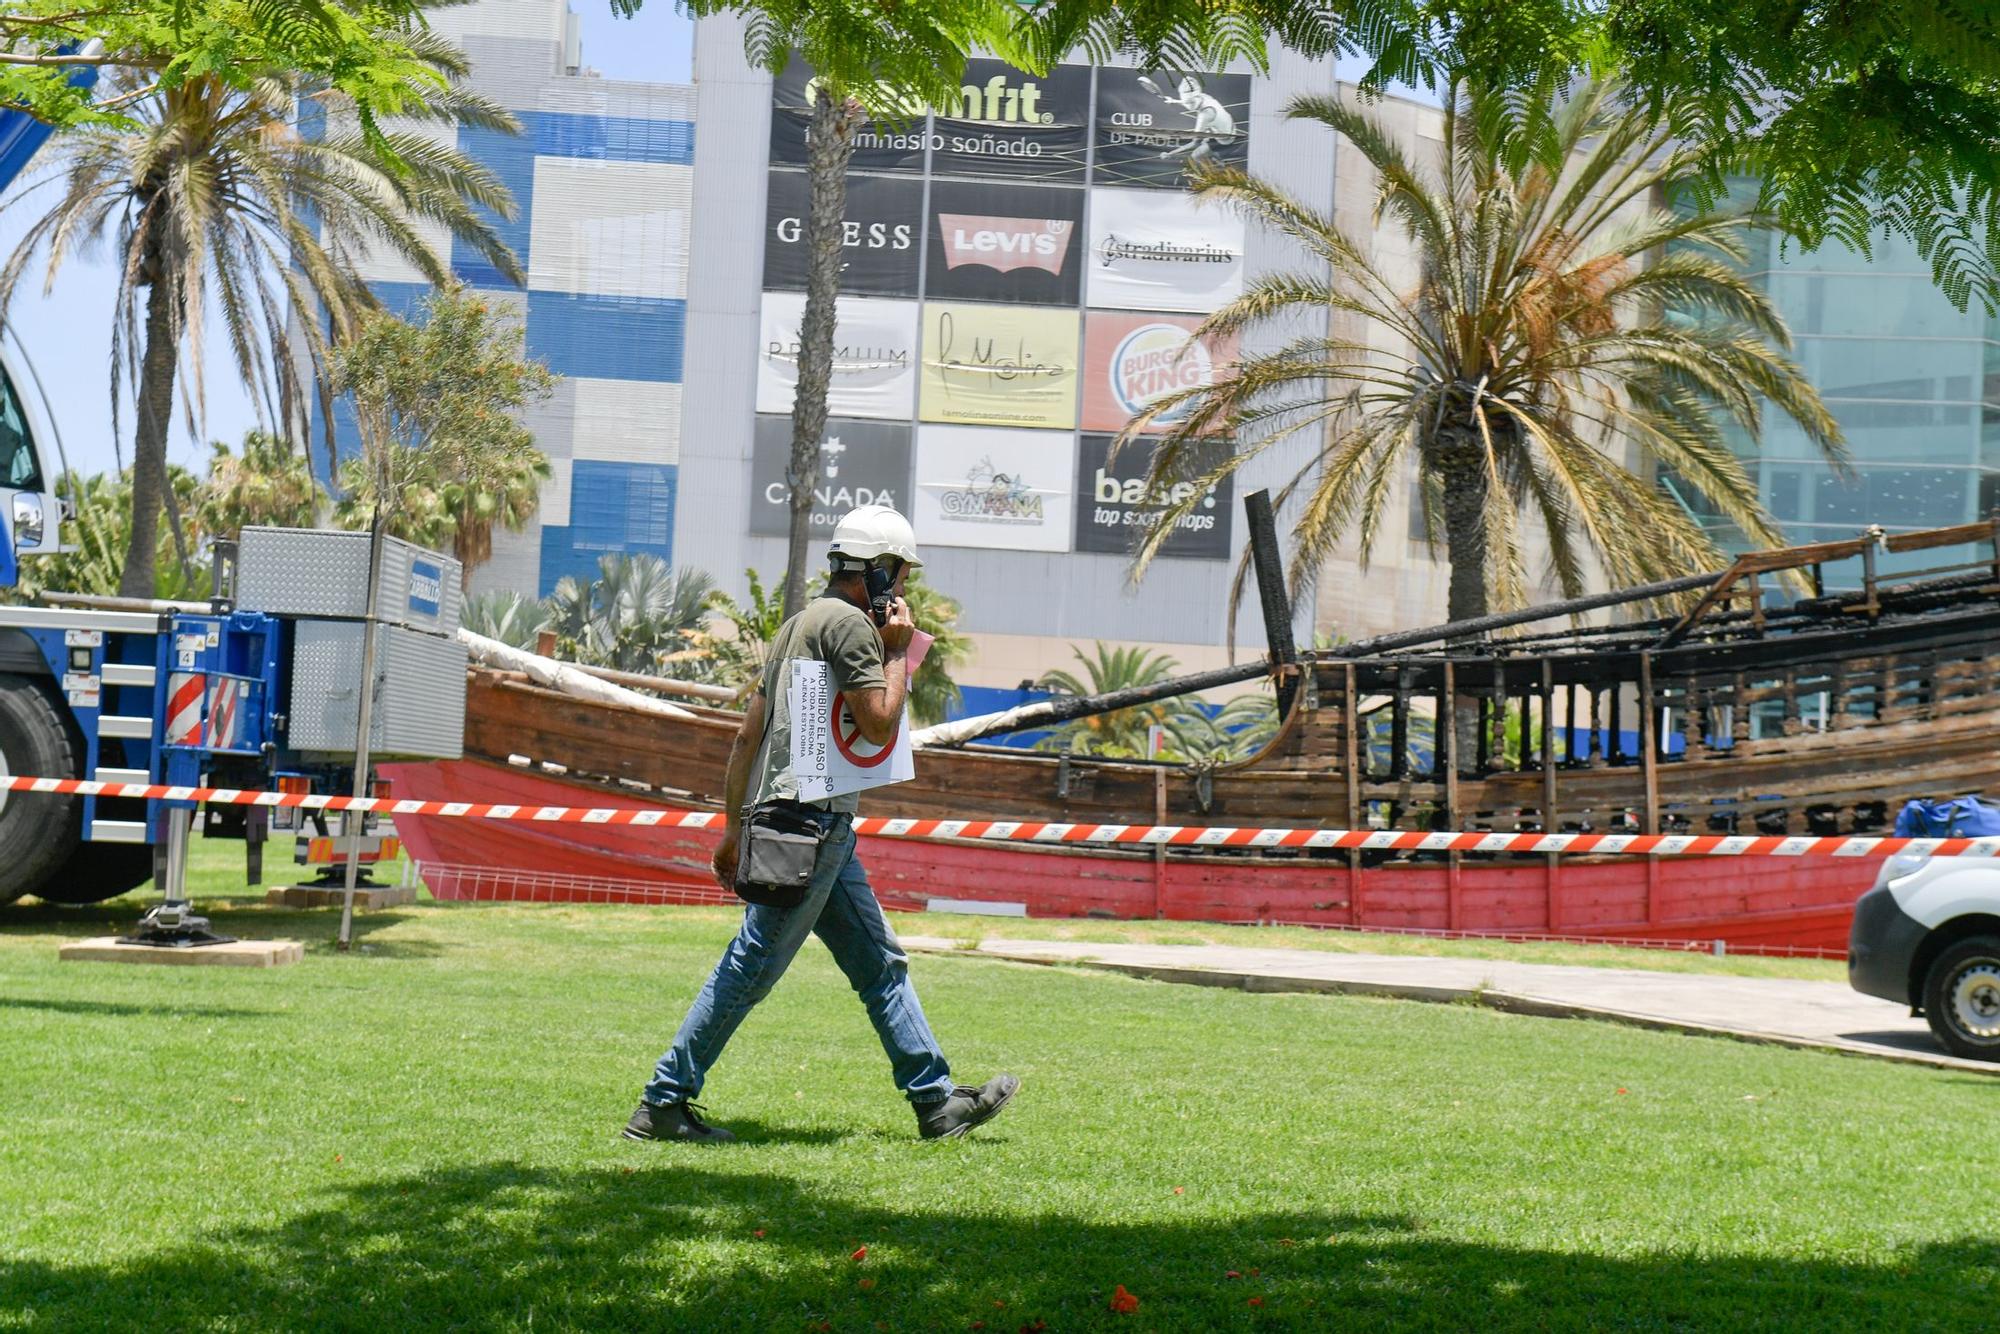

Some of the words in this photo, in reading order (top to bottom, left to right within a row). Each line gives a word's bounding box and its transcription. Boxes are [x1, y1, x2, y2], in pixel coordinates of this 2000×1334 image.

[1111, 112, 1153, 127] CLUB
[850, 131, 945, 153] imnasio
[952, 133, 1042, 158] soñado
[1110, 132, 1131, 144] DE
[776, 217, 912, 250] GESS
[1124, 345, 1197, 376] BURGR
[1126, 360, 1201, 401] KING
[765, 482, 895, 509] CNADA
[1093, 506, 1120, 527] top
[817, 664, 828, 724] PROHIBIDO
[807, 713, 816, 757] PERSONA
[816, 726, 827, 739] EL
[815, 744, 826, 771] PASO
